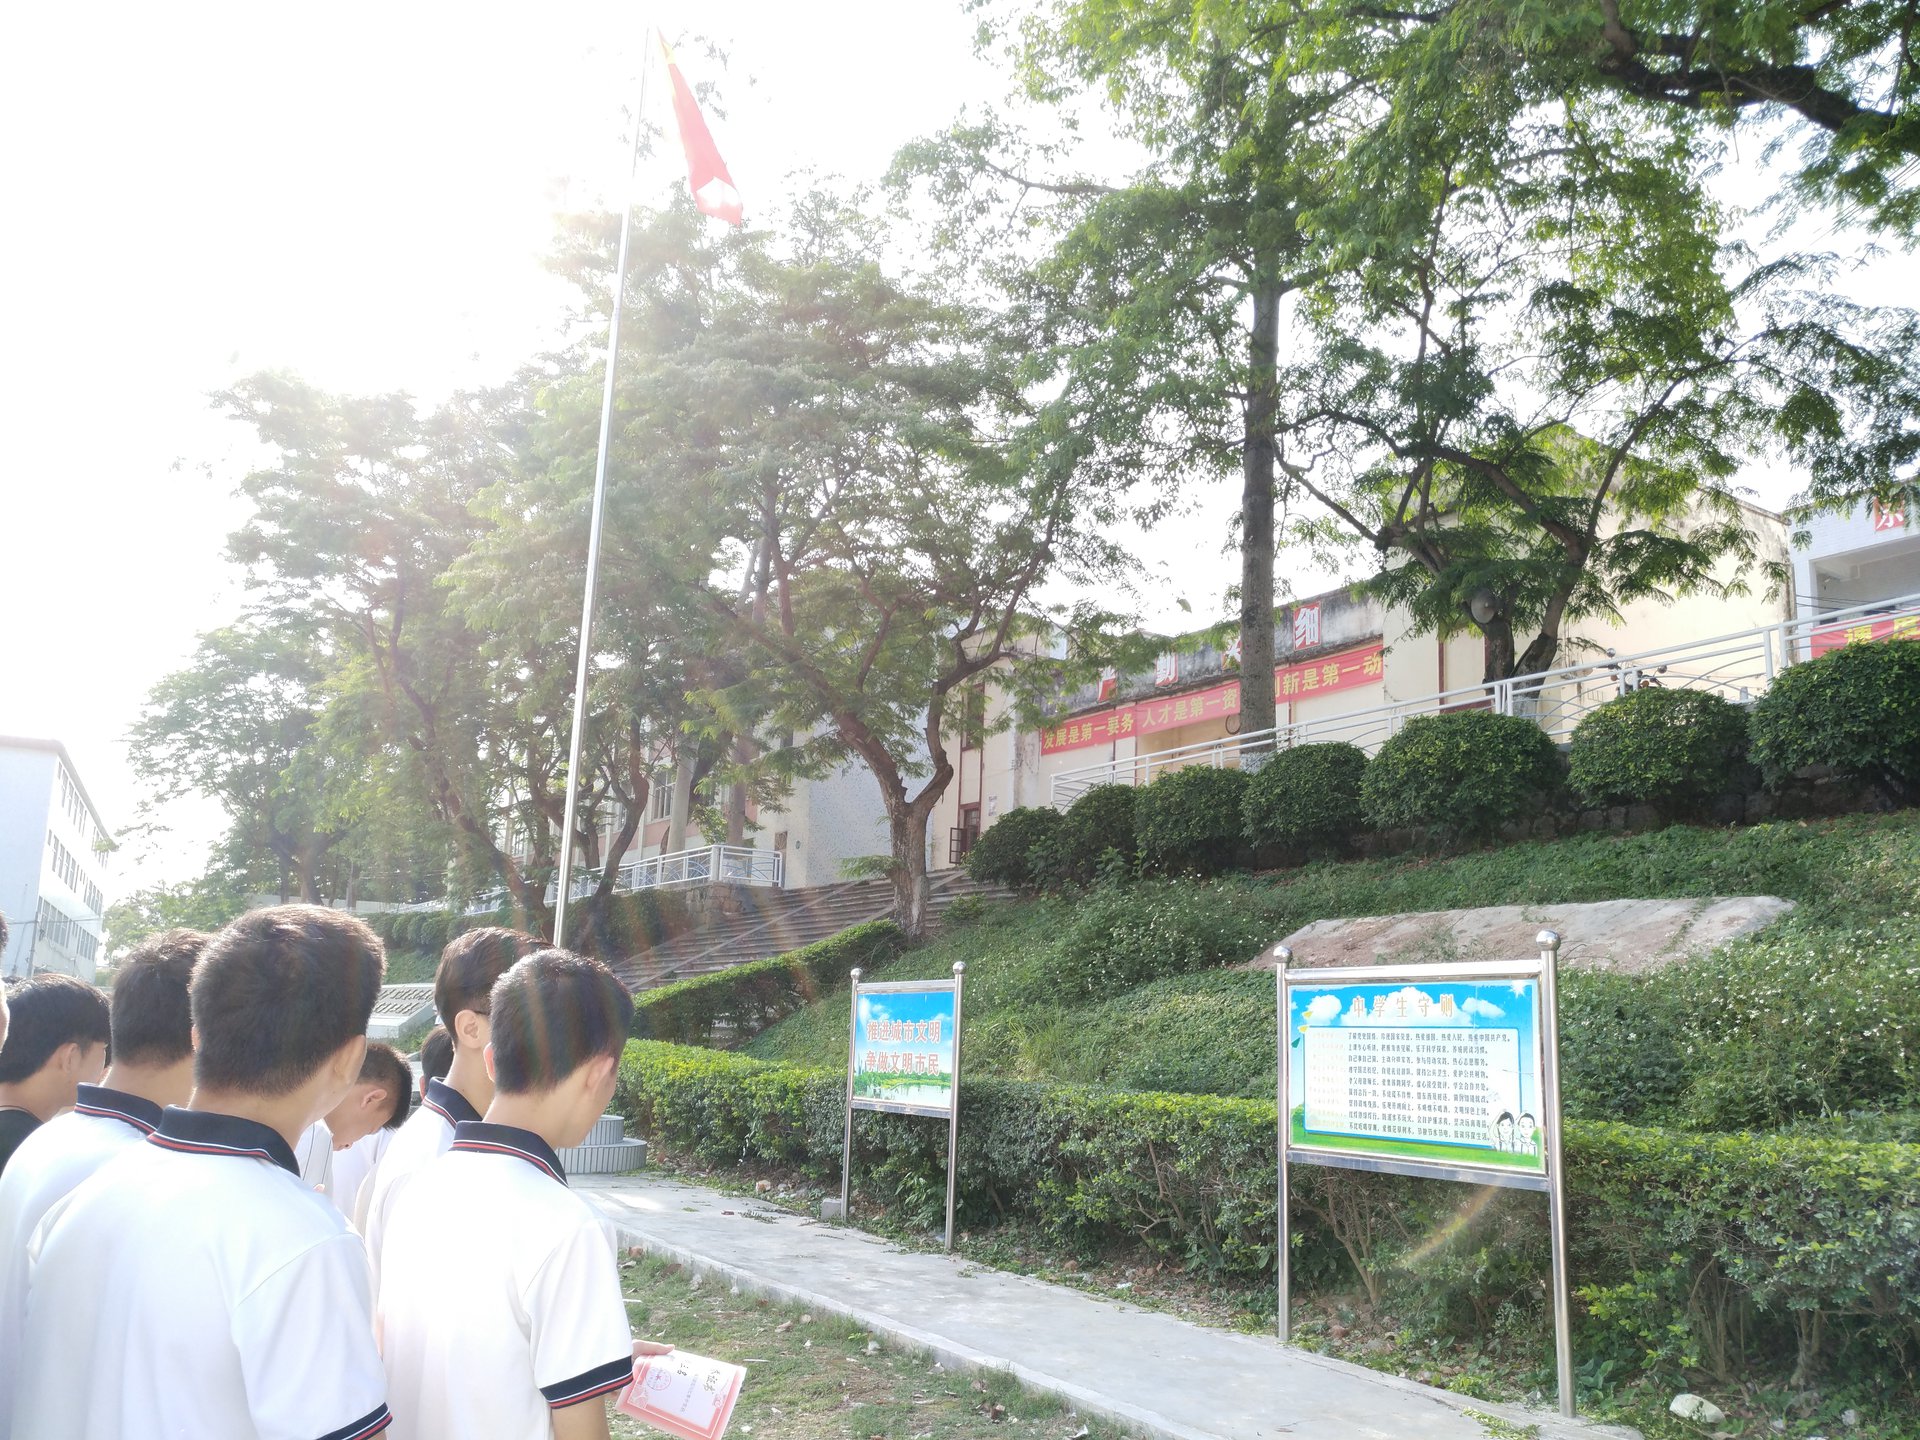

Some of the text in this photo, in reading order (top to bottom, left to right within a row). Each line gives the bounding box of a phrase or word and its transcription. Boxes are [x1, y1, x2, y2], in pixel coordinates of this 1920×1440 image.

[1295, 606, 1319, 648] 细
[1043, 713, 1134, 750] 发展是第一要务
[1353, 995, 1453, 1018] 中学生守则
[867, 1019, 942, 1044] 推进城市文明
[865, 1050, 940, 1077] 争做文明市民
